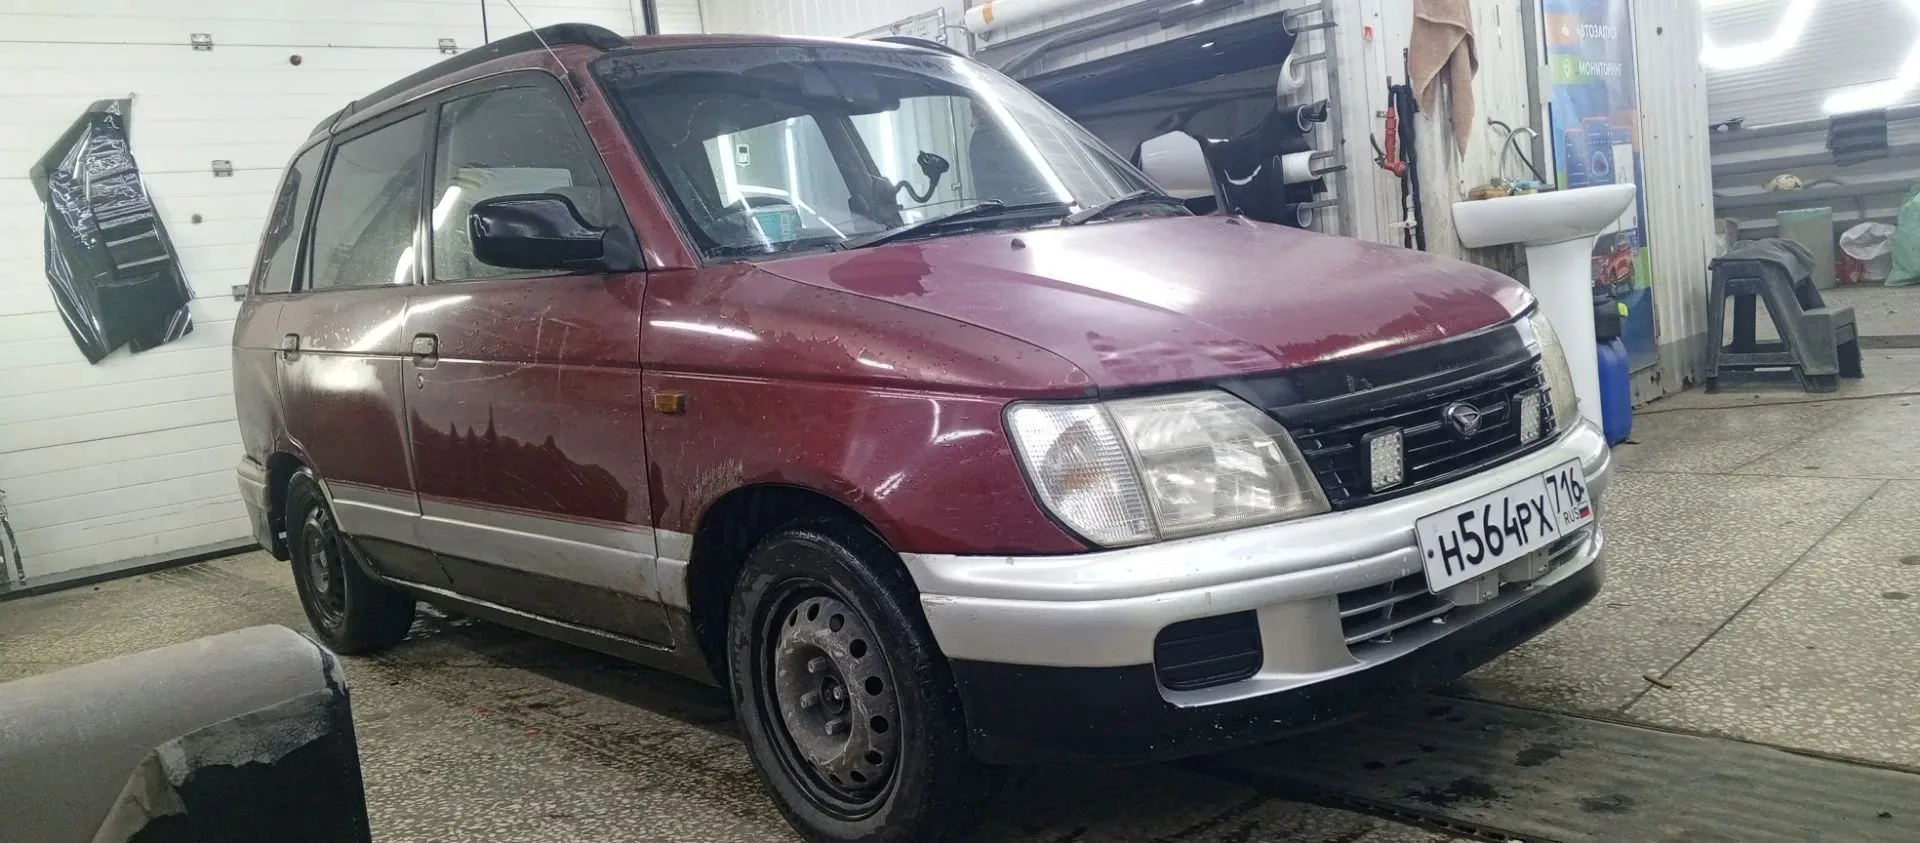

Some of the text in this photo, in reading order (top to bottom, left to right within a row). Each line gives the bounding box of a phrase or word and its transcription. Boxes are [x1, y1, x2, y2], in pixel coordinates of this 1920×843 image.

[1578, 61, 1622, 76] МОНИТОРИНГ
[1546, 467, 1585, 513] 716
[1563, 506, 1580, 525] RUS
